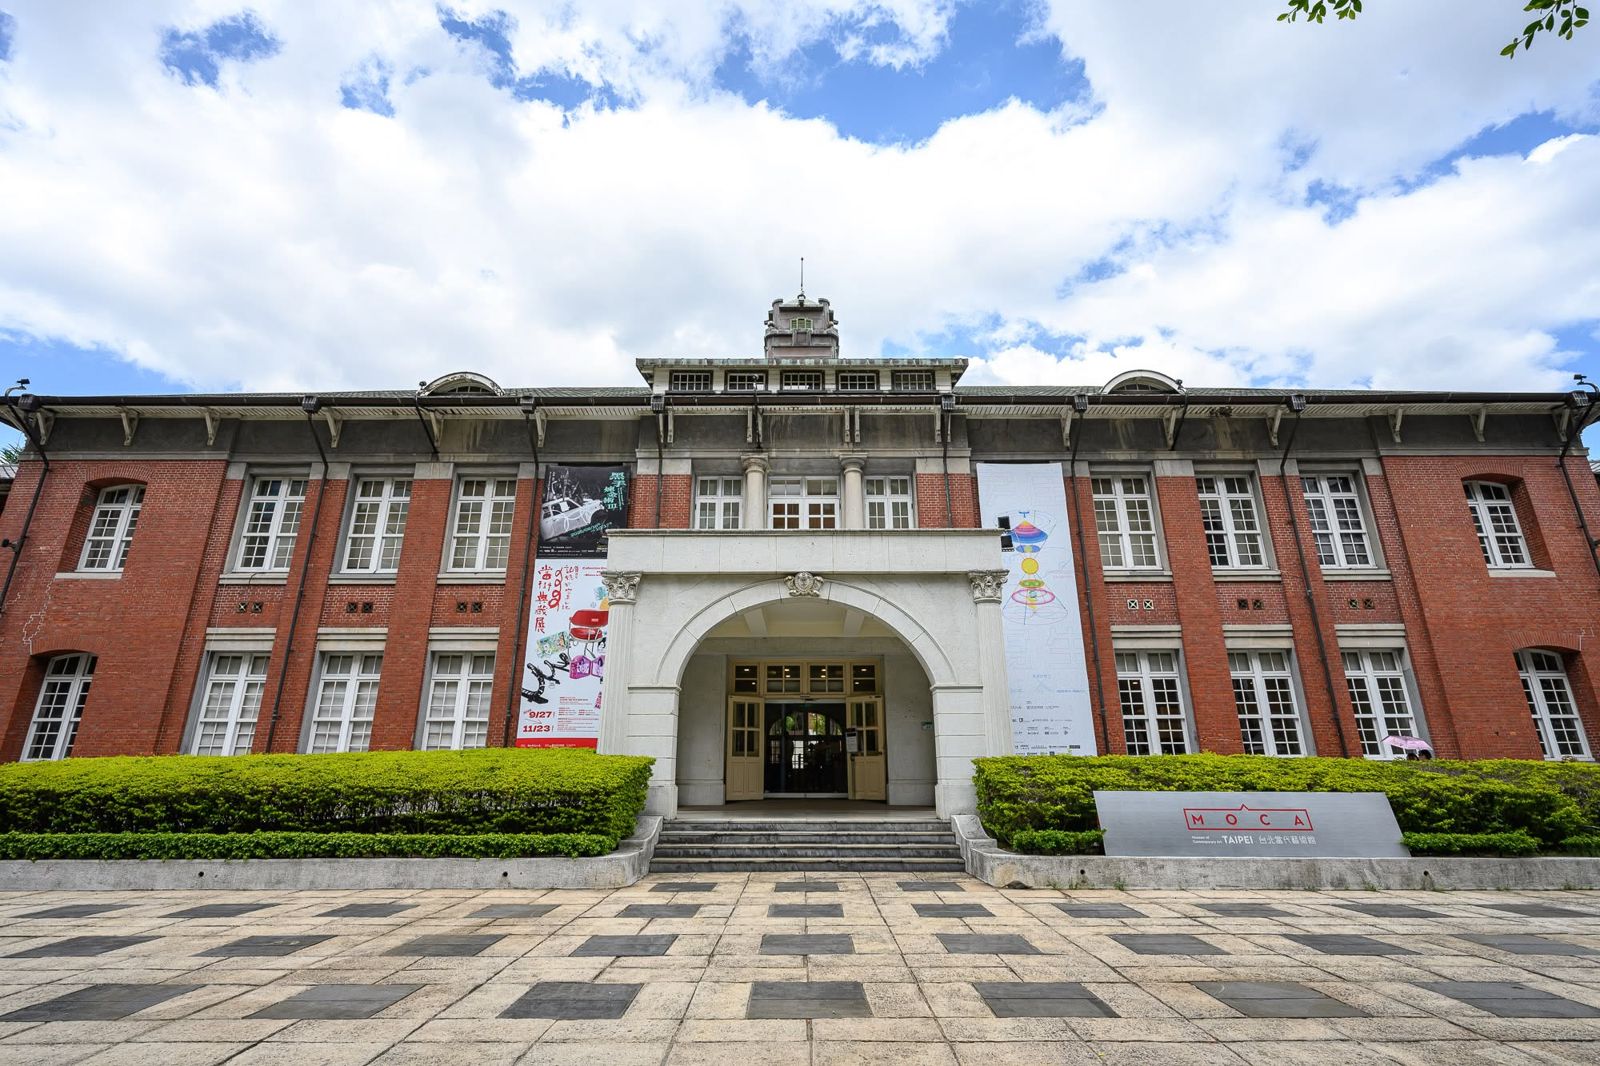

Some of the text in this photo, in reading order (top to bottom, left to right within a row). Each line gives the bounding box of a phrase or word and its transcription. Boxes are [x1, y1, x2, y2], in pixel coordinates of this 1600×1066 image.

[529, 711, 552, 719] 9/27
[523, 725, 551, 733] 11/23
[1191, 814, 1304, 826] MOCA
[1221, 835, 1254, 844] TAIPEI
[1258, 835, 1316, 845] 台北當代藝術館
